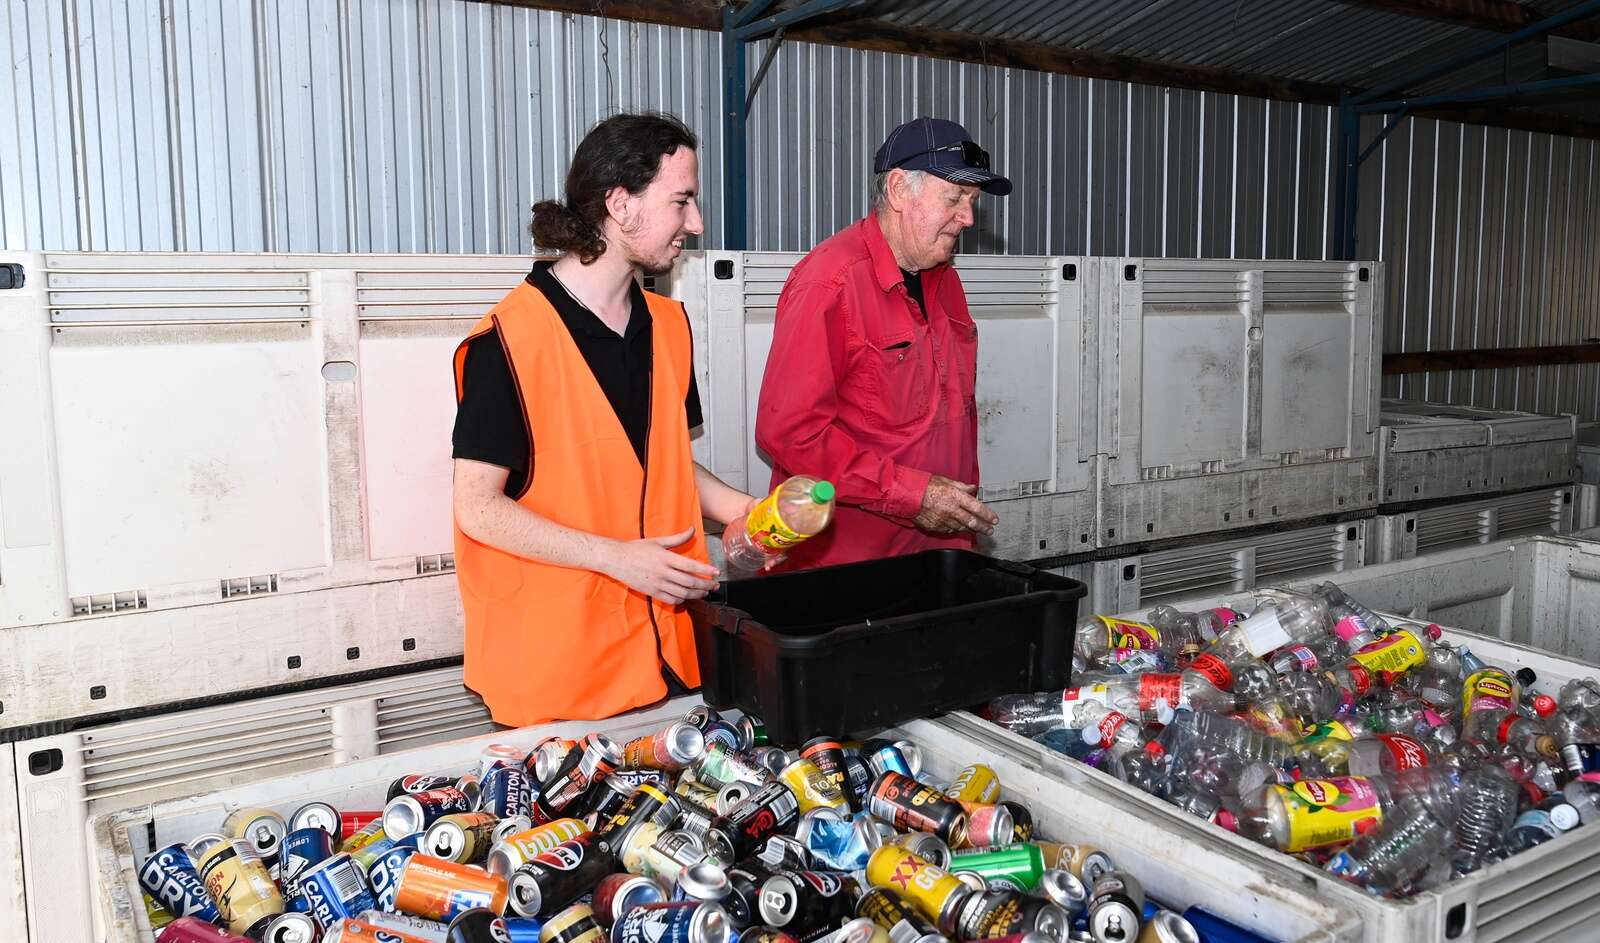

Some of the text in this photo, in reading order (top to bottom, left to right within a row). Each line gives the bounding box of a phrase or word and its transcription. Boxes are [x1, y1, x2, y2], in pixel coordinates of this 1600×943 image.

[1481, 682, 1509, 694] Lipton
[505, 771, 520, 818] CARLTON
[622, 773, 660, 786] CARL
[142, 861, 204, 917] DRY
[158, 853, 211, 907] CARLTON
[369, 860, 395, 913] DR
[915, 866, 943, 890] GO
[305, 881, 336, 927] CARL
